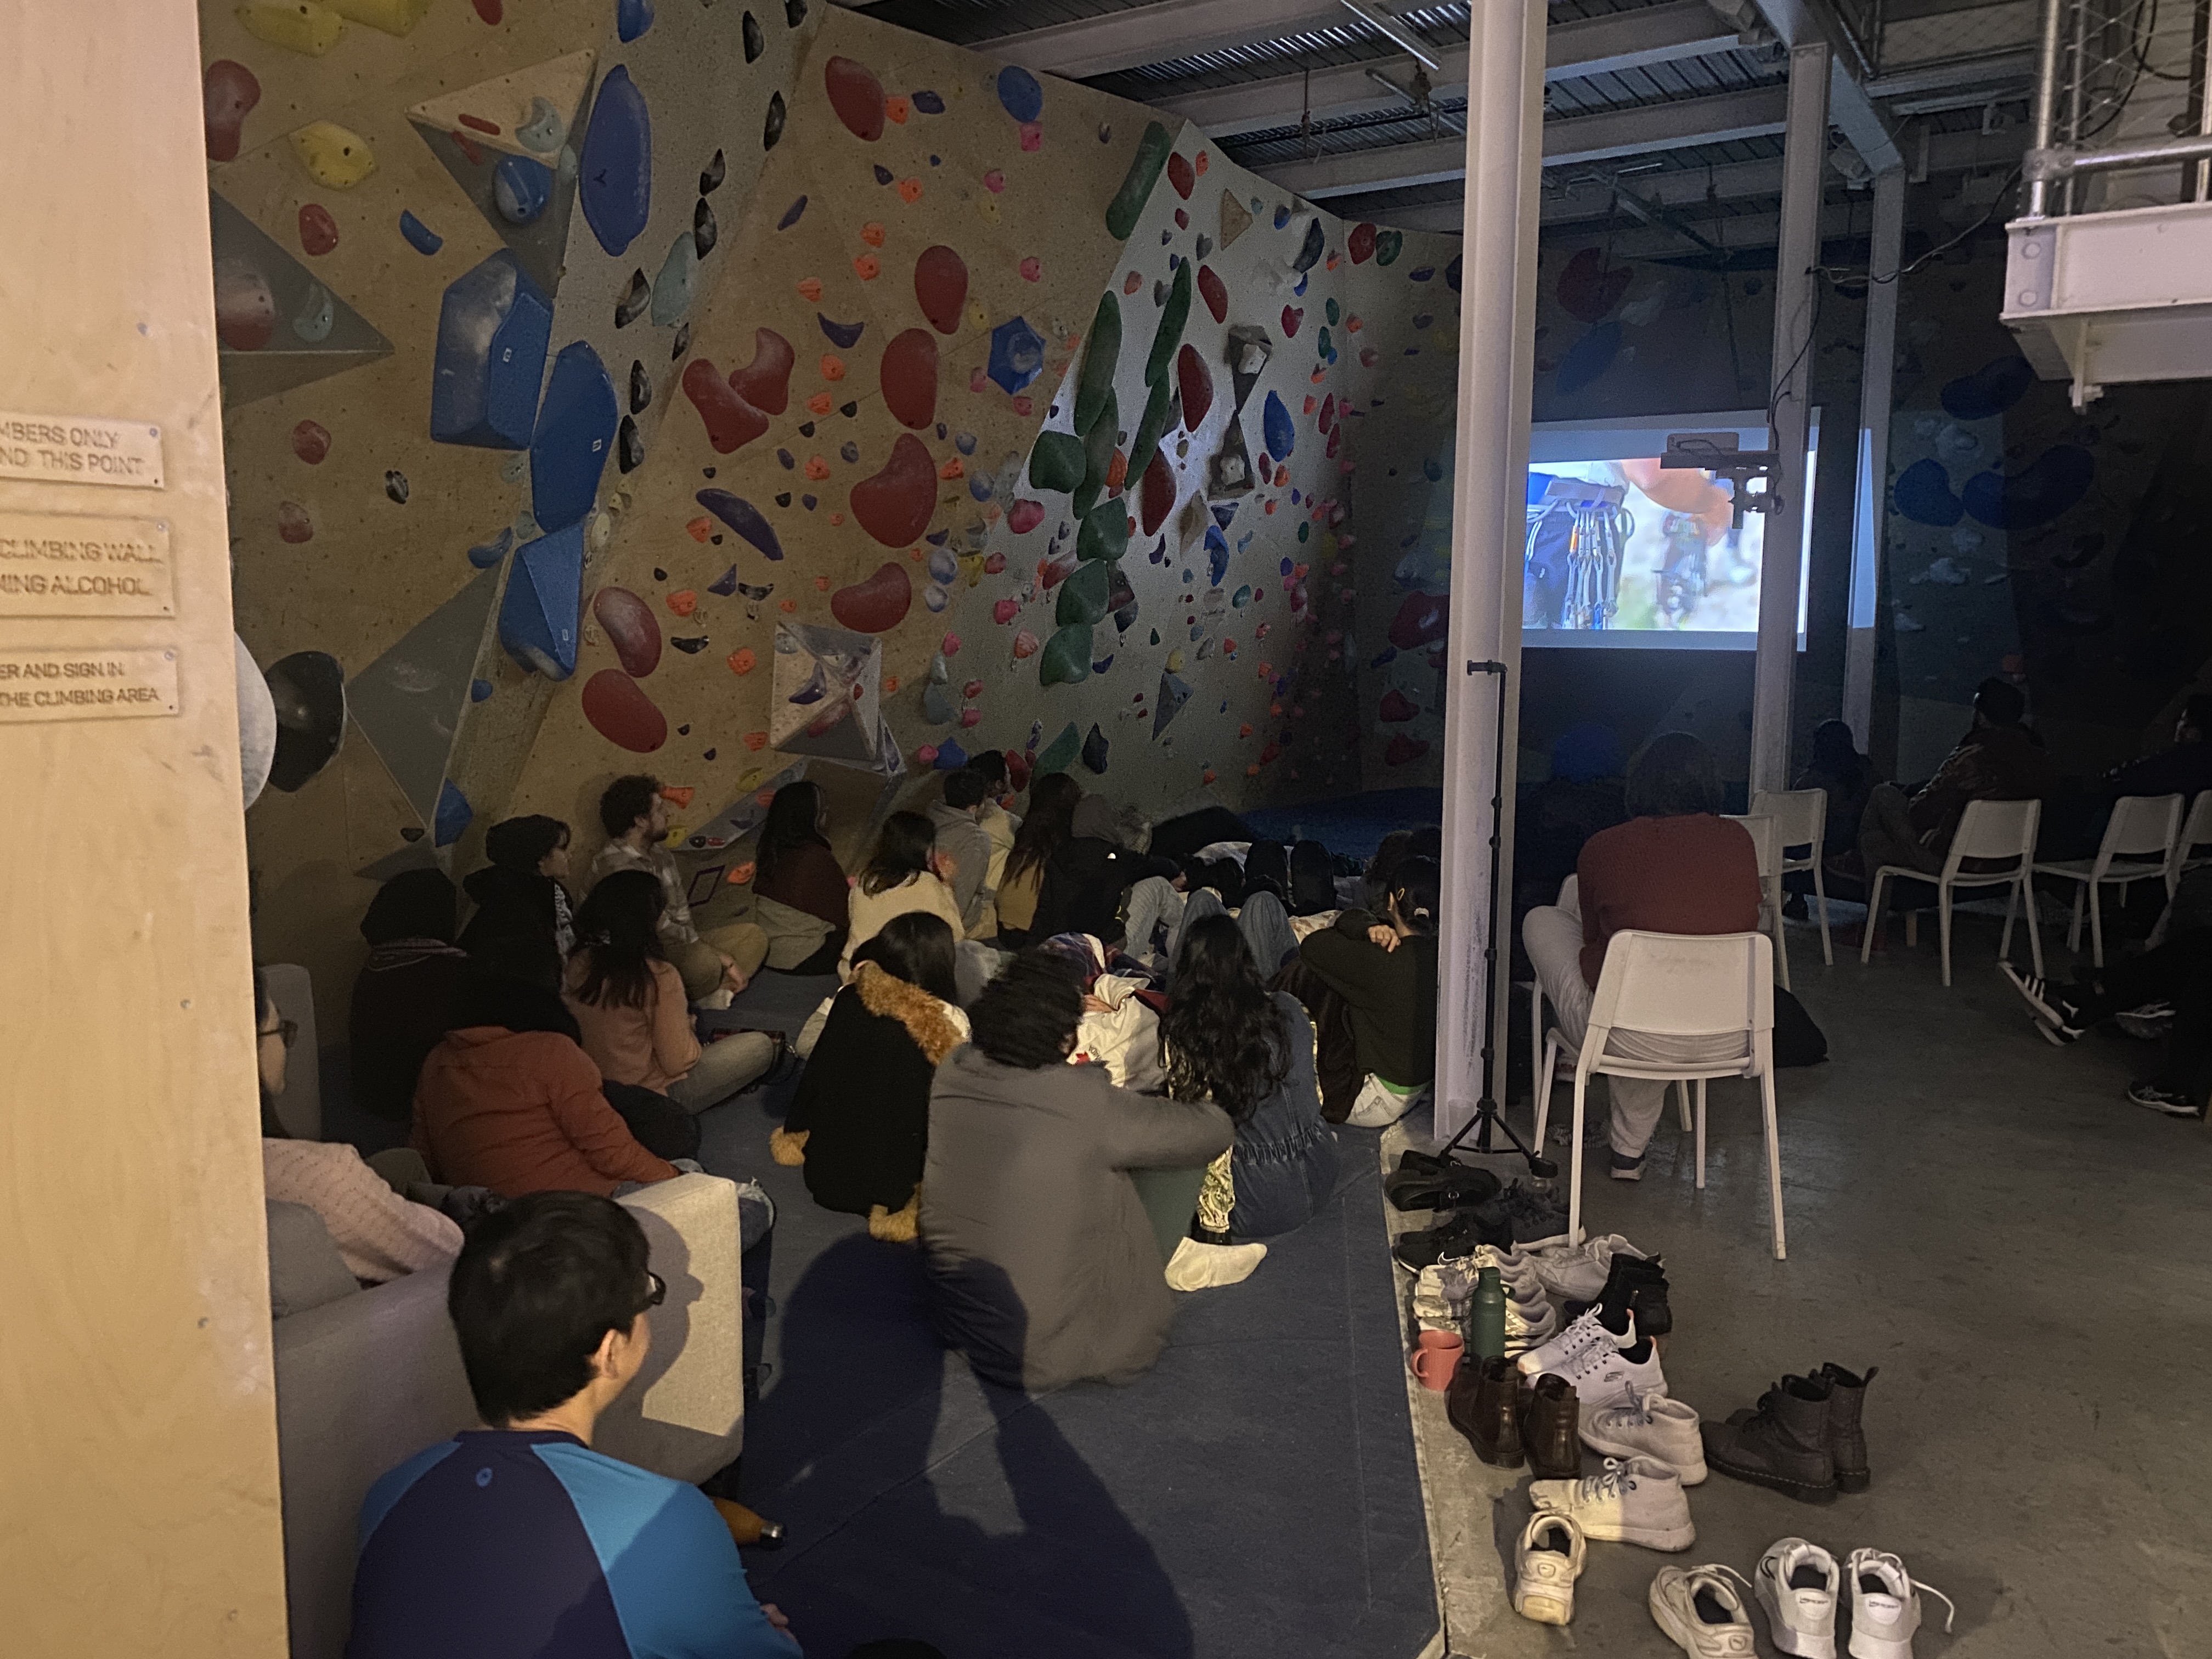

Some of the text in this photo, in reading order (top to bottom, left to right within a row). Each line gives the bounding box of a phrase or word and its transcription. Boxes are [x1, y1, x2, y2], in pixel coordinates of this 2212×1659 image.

[70, 427, 119, 448] ONLY
[37, 449, 83, 471] THIS
[88, 453, 144, 474] POINT
[0, 539, 163, 564] CLIMBING WALL
[51, 575, 154, 596] ALCOHOL
[23, 663, 60, 679] AND
[63, 662, 105, 678] SIGN
[107, 662, 125, 677] IN
[34, 689, 114, 707] CLIMBING
[116, 687, 160, 704] AREA
